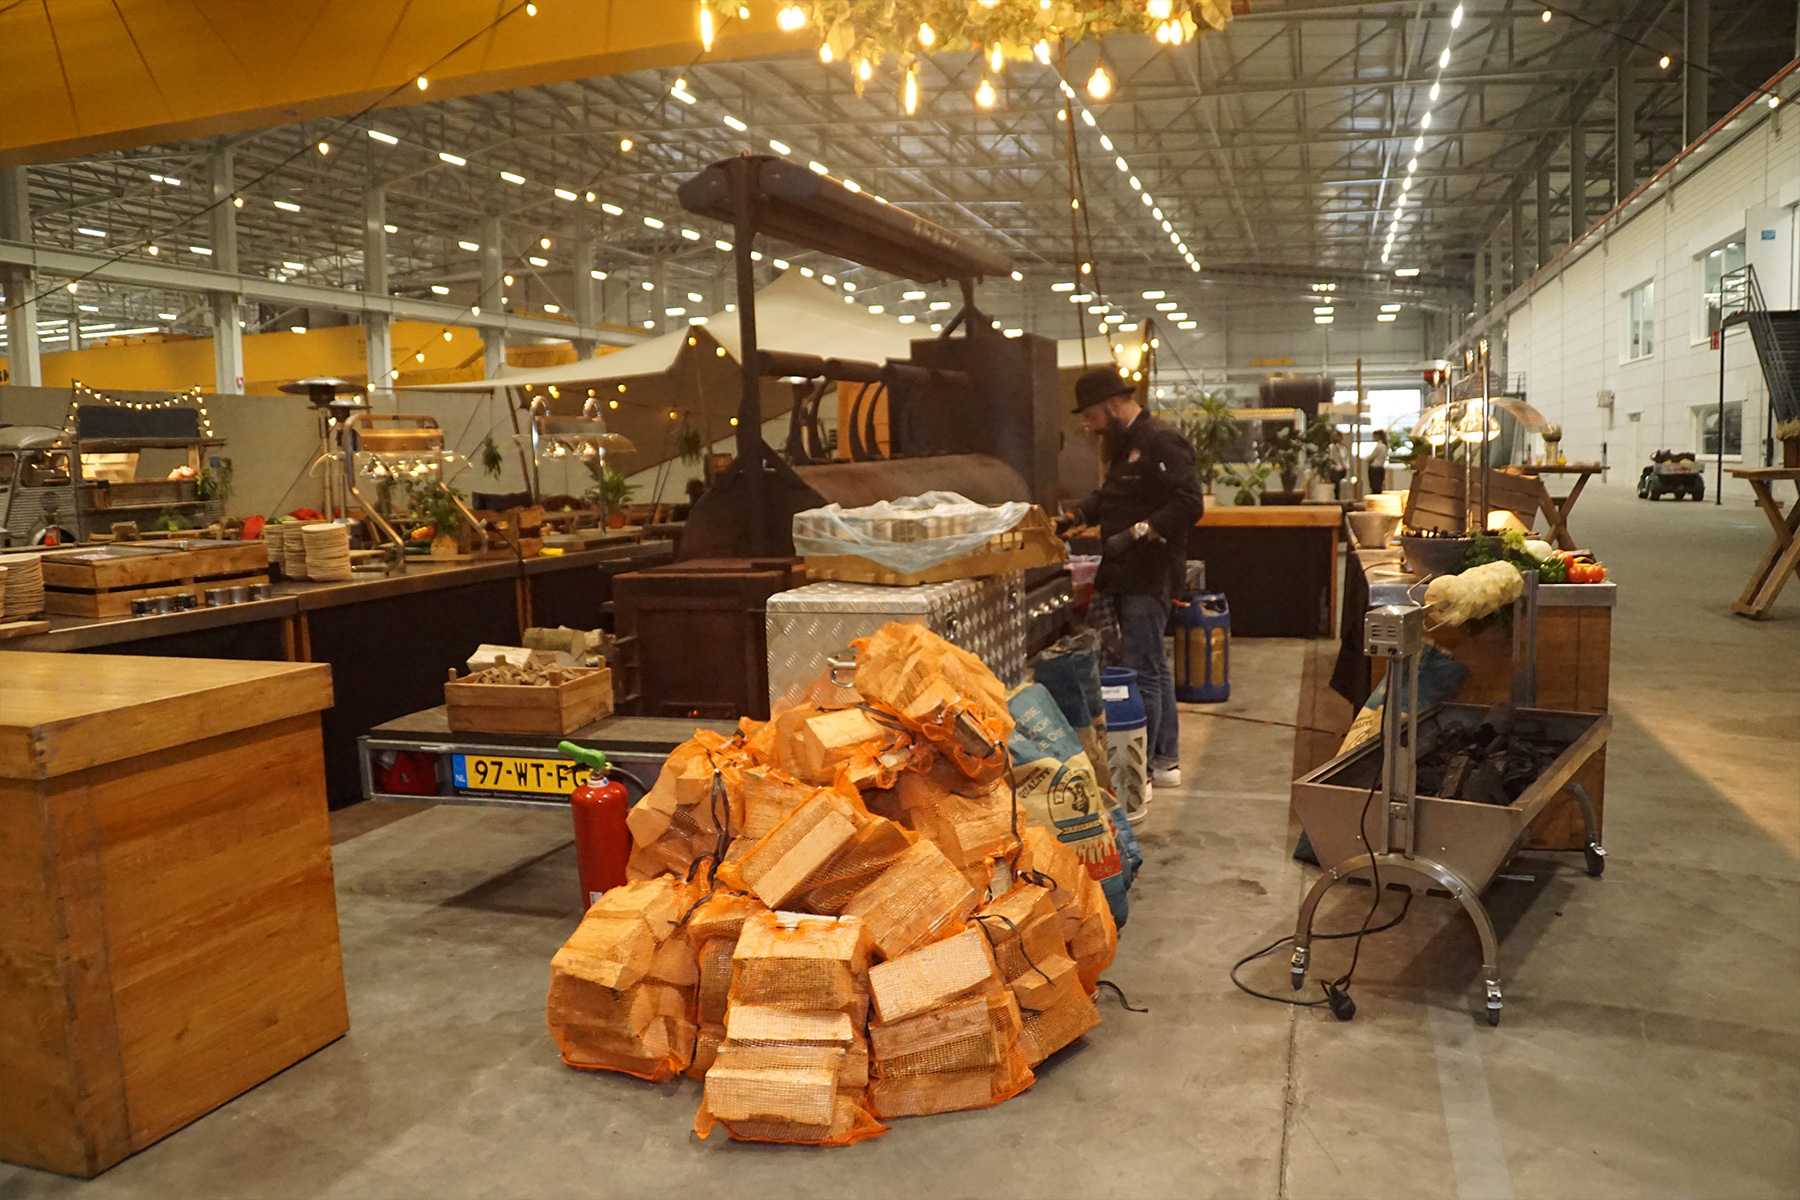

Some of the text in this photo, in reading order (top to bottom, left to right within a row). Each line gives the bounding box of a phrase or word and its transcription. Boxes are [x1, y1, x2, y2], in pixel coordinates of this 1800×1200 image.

[455, 774, 466, 783] NL
[475, 760, 588, 788] 97-WT-FG
[1017, 767, 1051, 799] QUALITY
